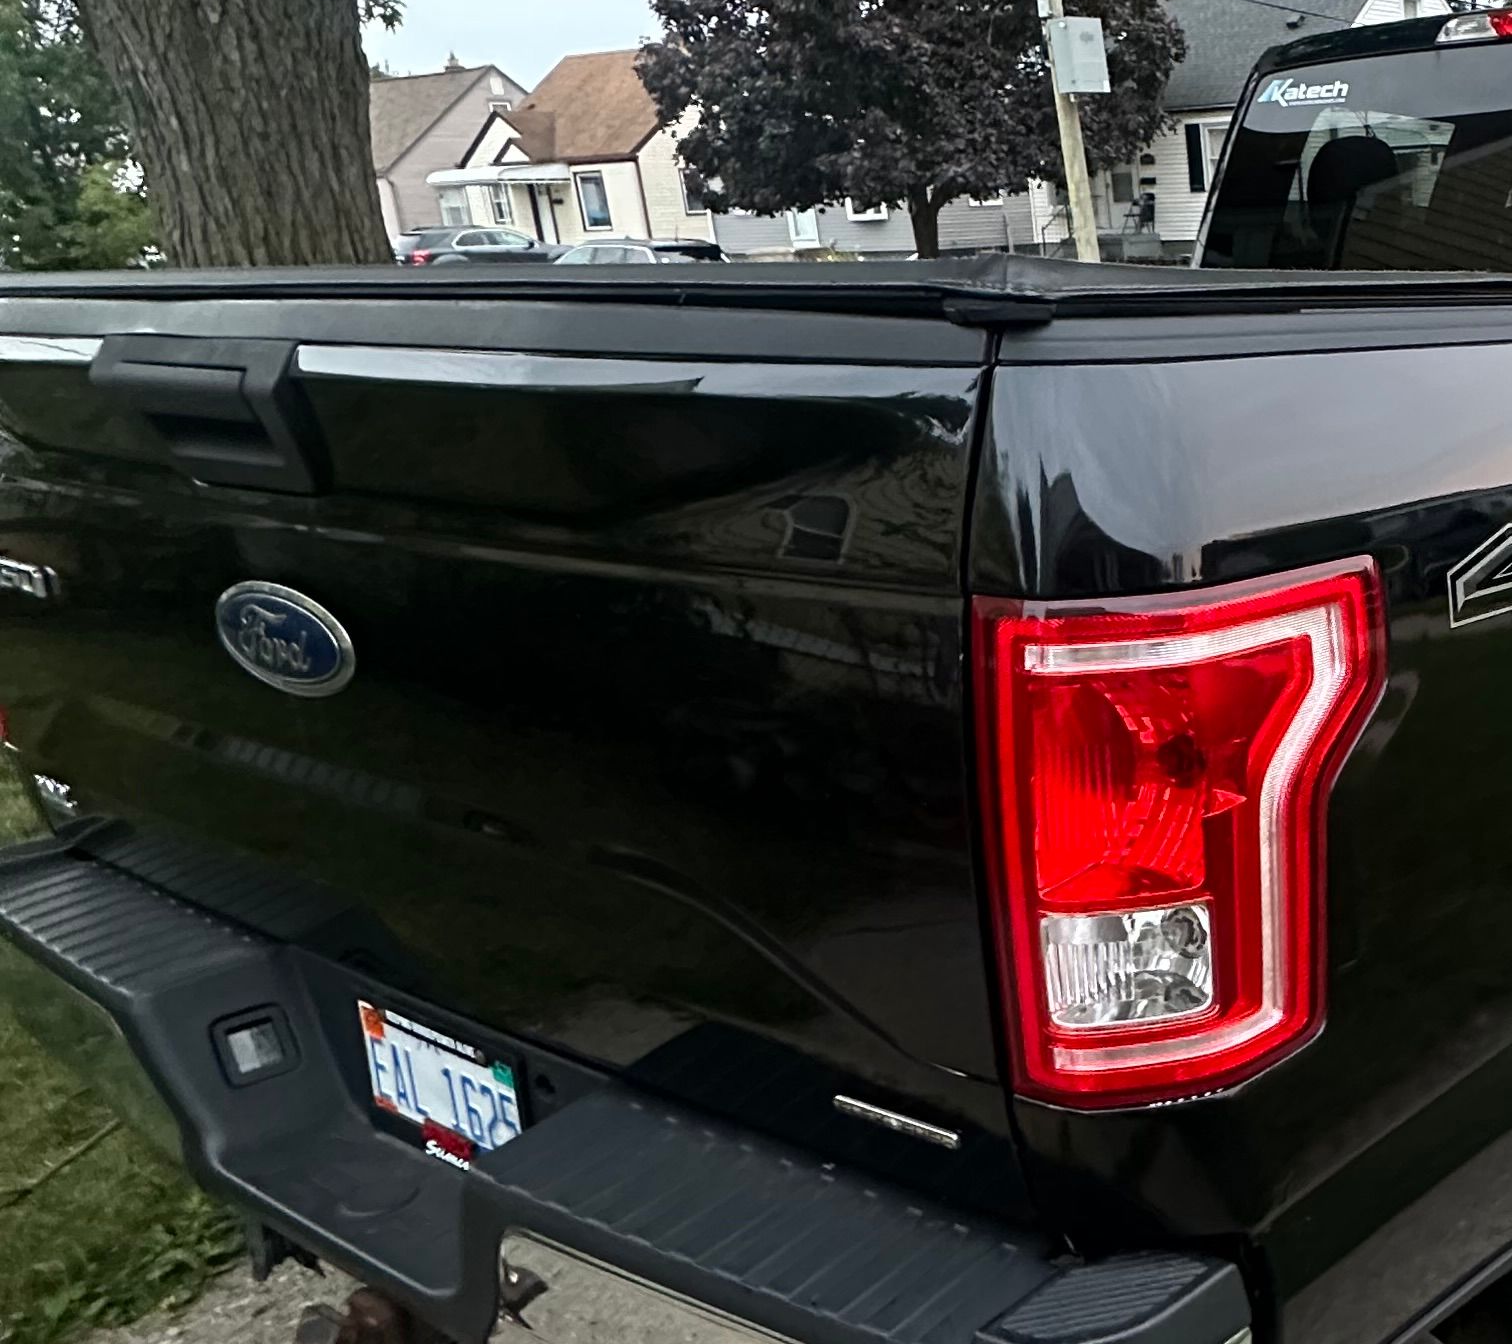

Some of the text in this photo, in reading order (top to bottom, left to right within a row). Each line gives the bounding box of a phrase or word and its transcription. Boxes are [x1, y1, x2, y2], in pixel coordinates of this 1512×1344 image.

[1270, 77, 1350, 108] Katech
[238, 604, 311, 672] Ford
[370, 1039, 520, 1147] EAL 1625
